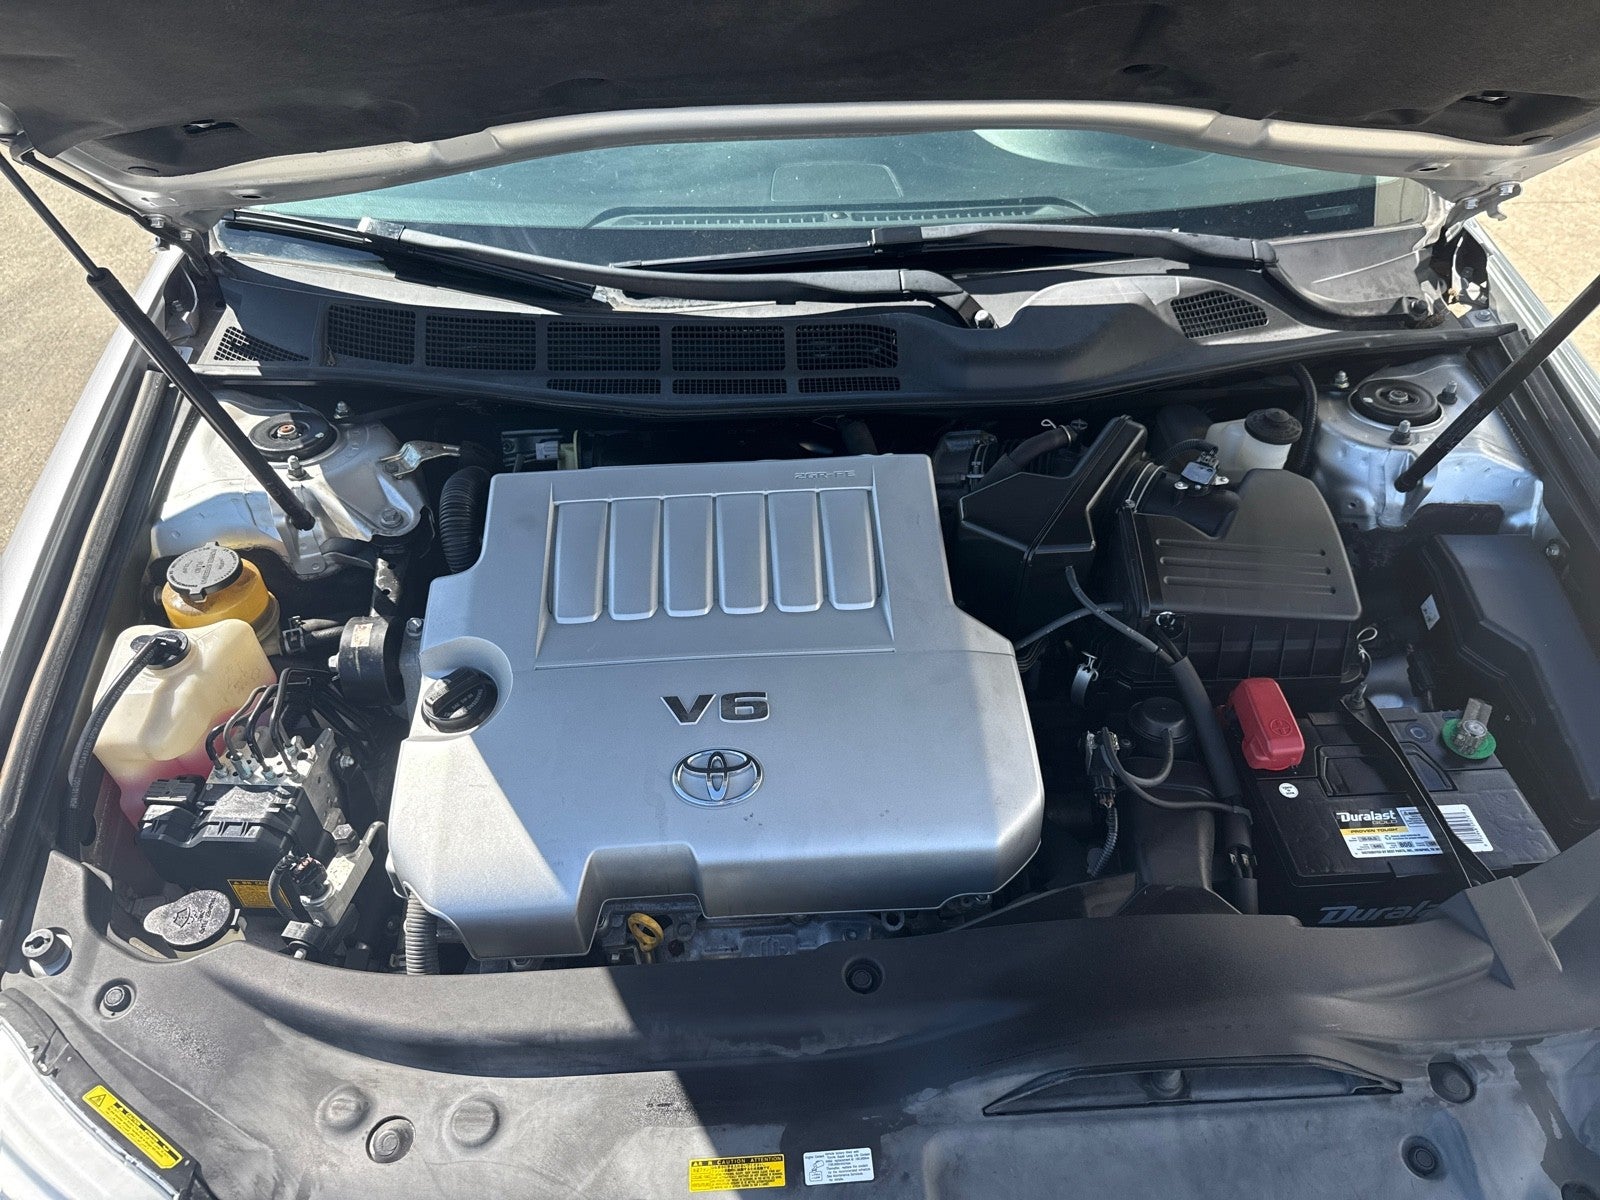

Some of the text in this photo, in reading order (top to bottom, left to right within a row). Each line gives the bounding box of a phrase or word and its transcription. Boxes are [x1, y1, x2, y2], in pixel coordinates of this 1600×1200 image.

[660, 691, 769, 726] V6
[1336, 810, 1397, 823] Duralast
[1318, 900, 1438, 924] Dural
[716, 1158, 746, 1166] CAUTION
